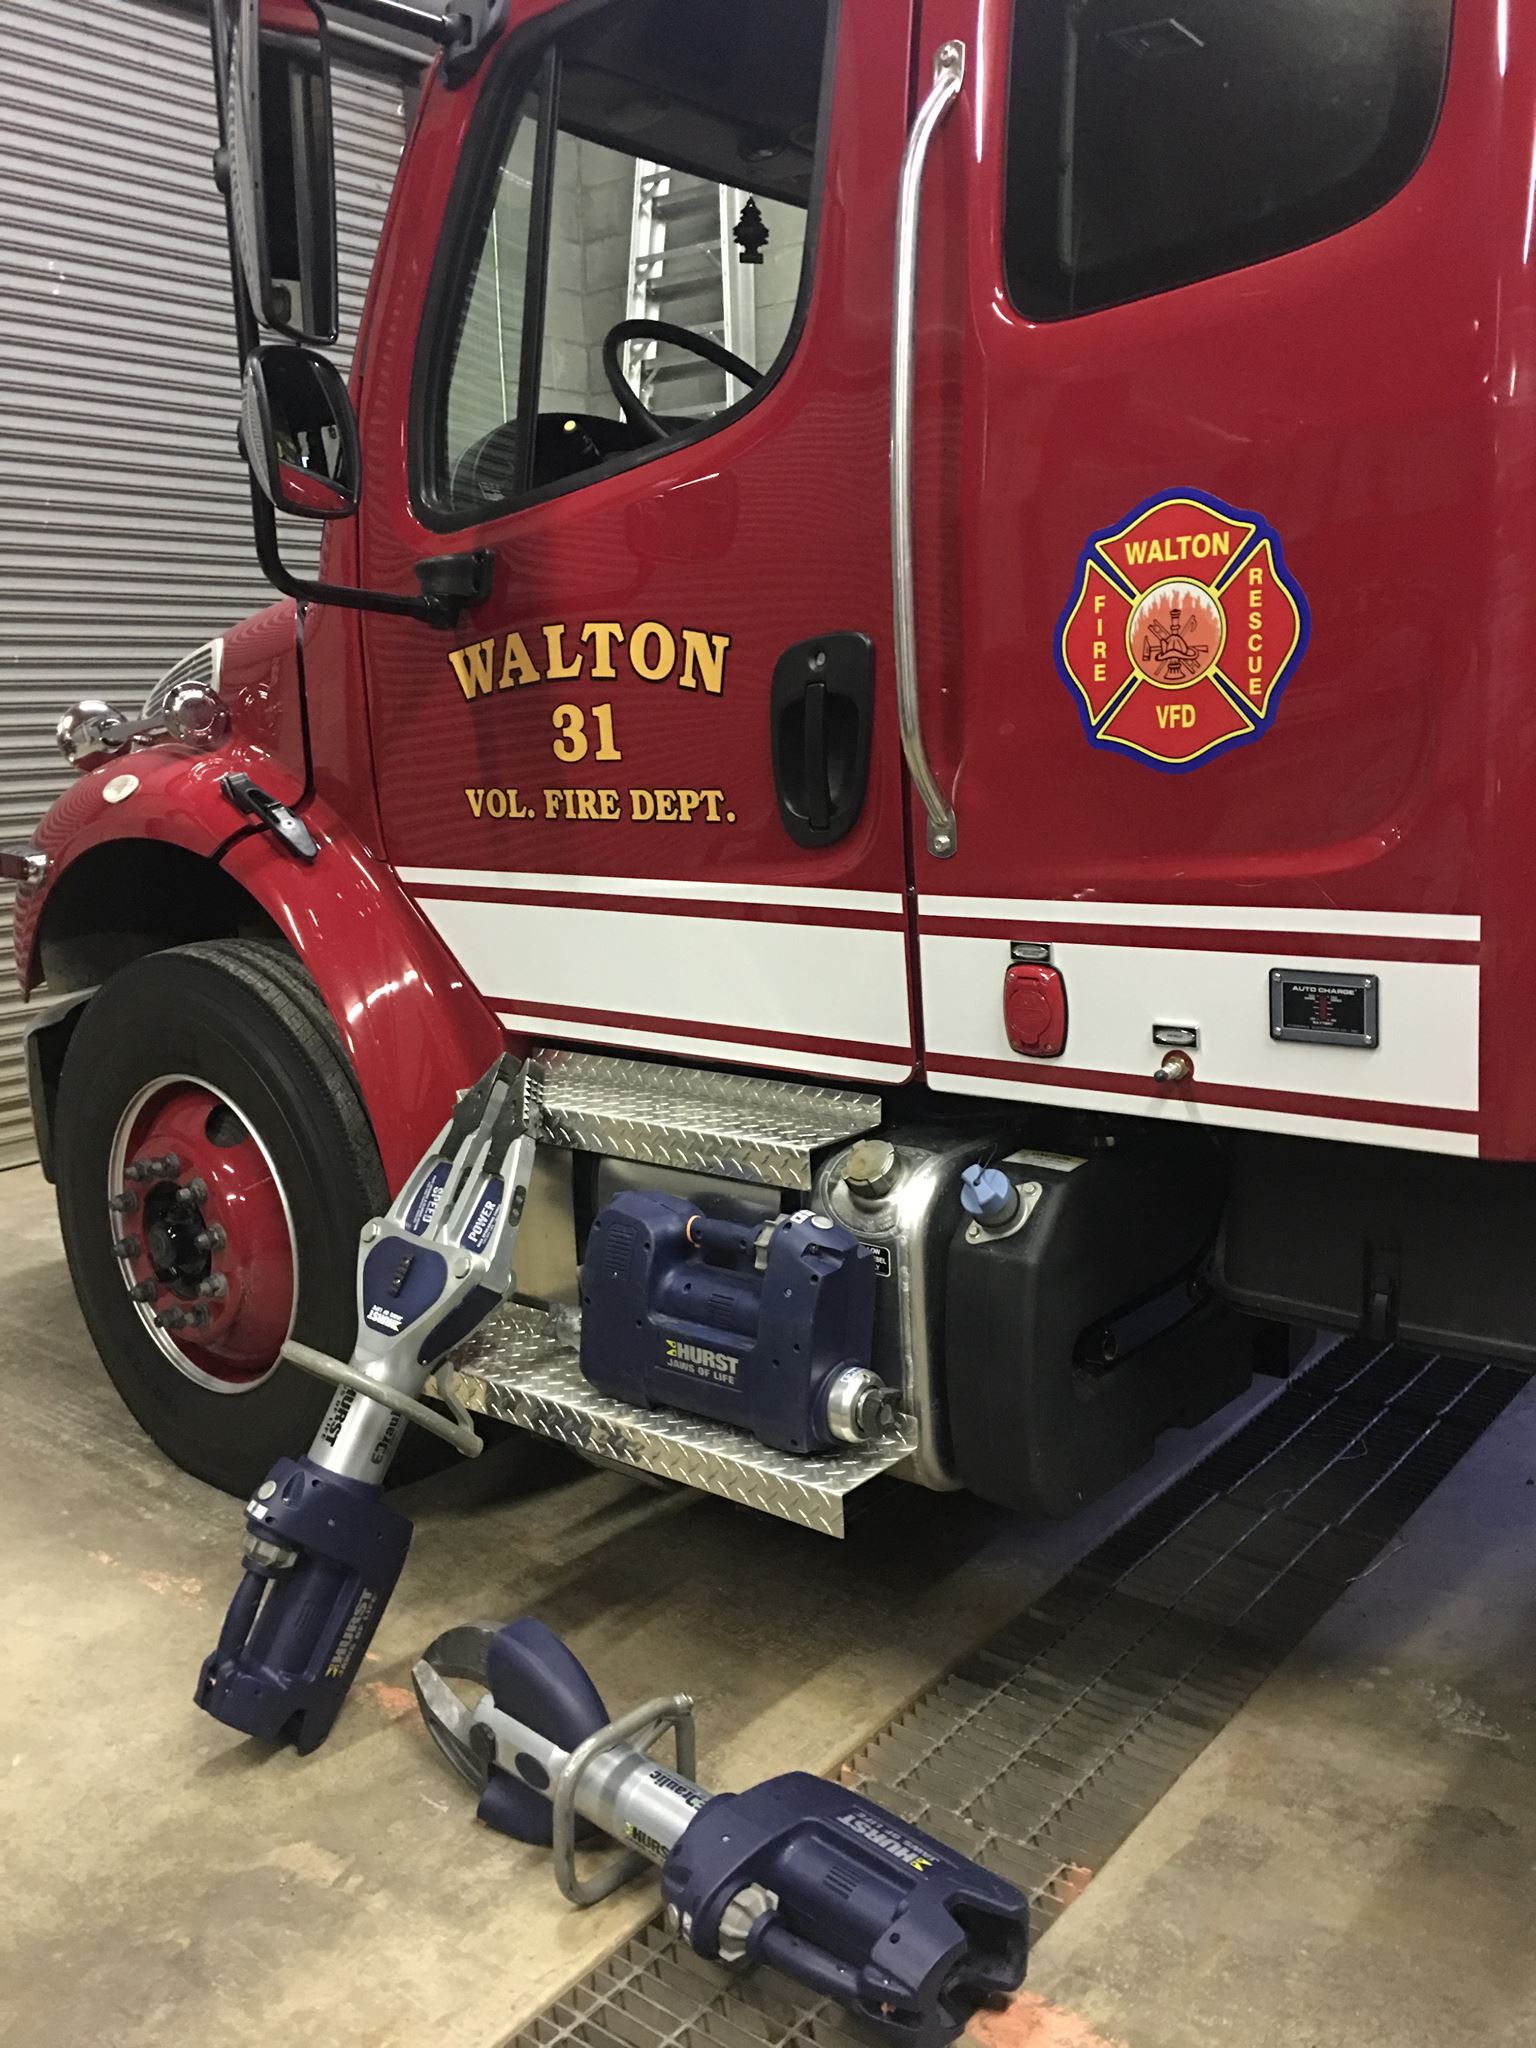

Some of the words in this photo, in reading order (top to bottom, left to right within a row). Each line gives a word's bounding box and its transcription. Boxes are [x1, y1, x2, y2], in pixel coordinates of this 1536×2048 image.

[1125, 531, 1230, 565] WALTON
[1093, 595, 1107, 682] FIRE
[1248, 567, 1263, 695] RESCUE
[449, 621, 730, 701] WALTON
[552, 703, 622, 762] 31
[1156, 704, 1196, 728] VFD
[465, 788, 536, 819] VOL.
[543, 789, 621, 820] FIRE
[629, 789, 737, 823] DEPT.
[1292, 985, 1317, 993] AUTO
[1318, 987, 1355, 996] CHARGE
[422, 1186, 444, 1223] SPEED
[467, 1200, 497, 1243] POWER
[667, 1358, 695, 1374] JAWS
[697, 1366, 711, 1377] OF
[713, 1371, 735, 1385] LIFE
[676, 1341, 739, 1375] HURST
[330, 1587, 373, 1664] HURST
[632, 1826, 671, 1861] HURS
[836, 1814, 919, 1864] HURST
